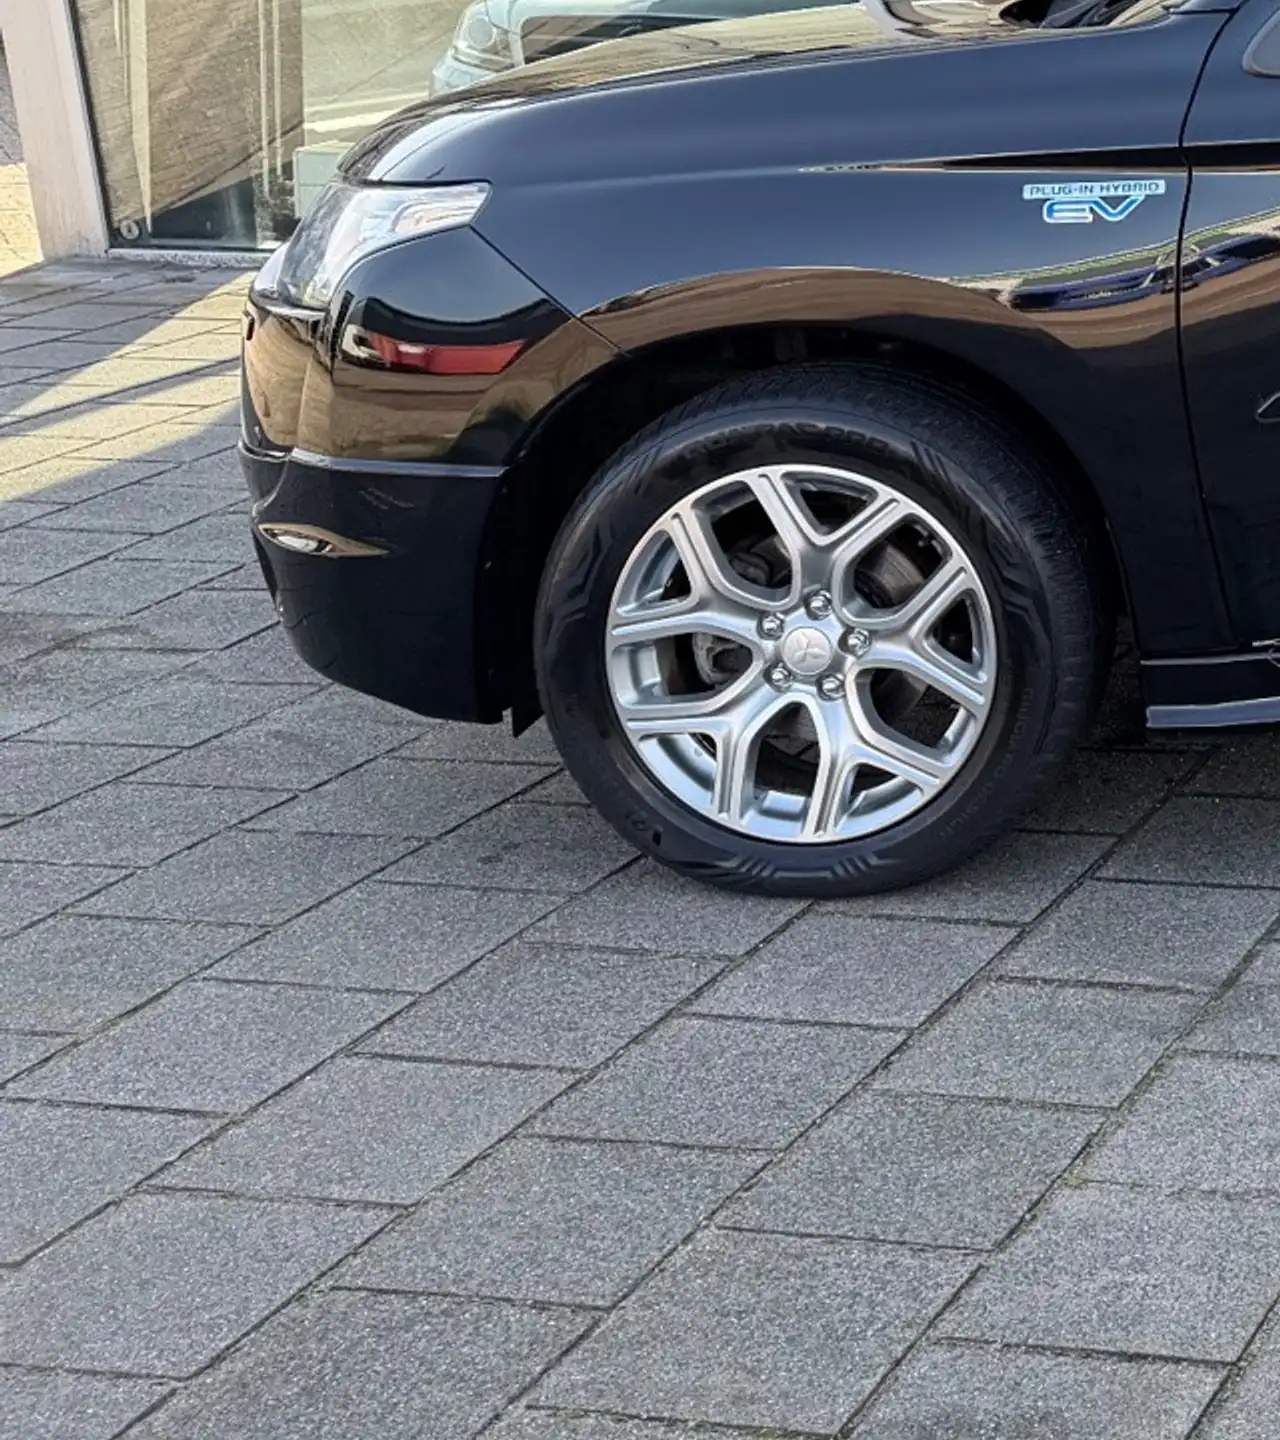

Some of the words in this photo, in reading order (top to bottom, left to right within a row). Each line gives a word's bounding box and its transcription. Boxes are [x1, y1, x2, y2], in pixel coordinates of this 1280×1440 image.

[1029, 184, 1095, 197] PLUG-IN
[1099, 181, 1160, 194] HYBRID
[1042, 194, 1146, 224] EV
